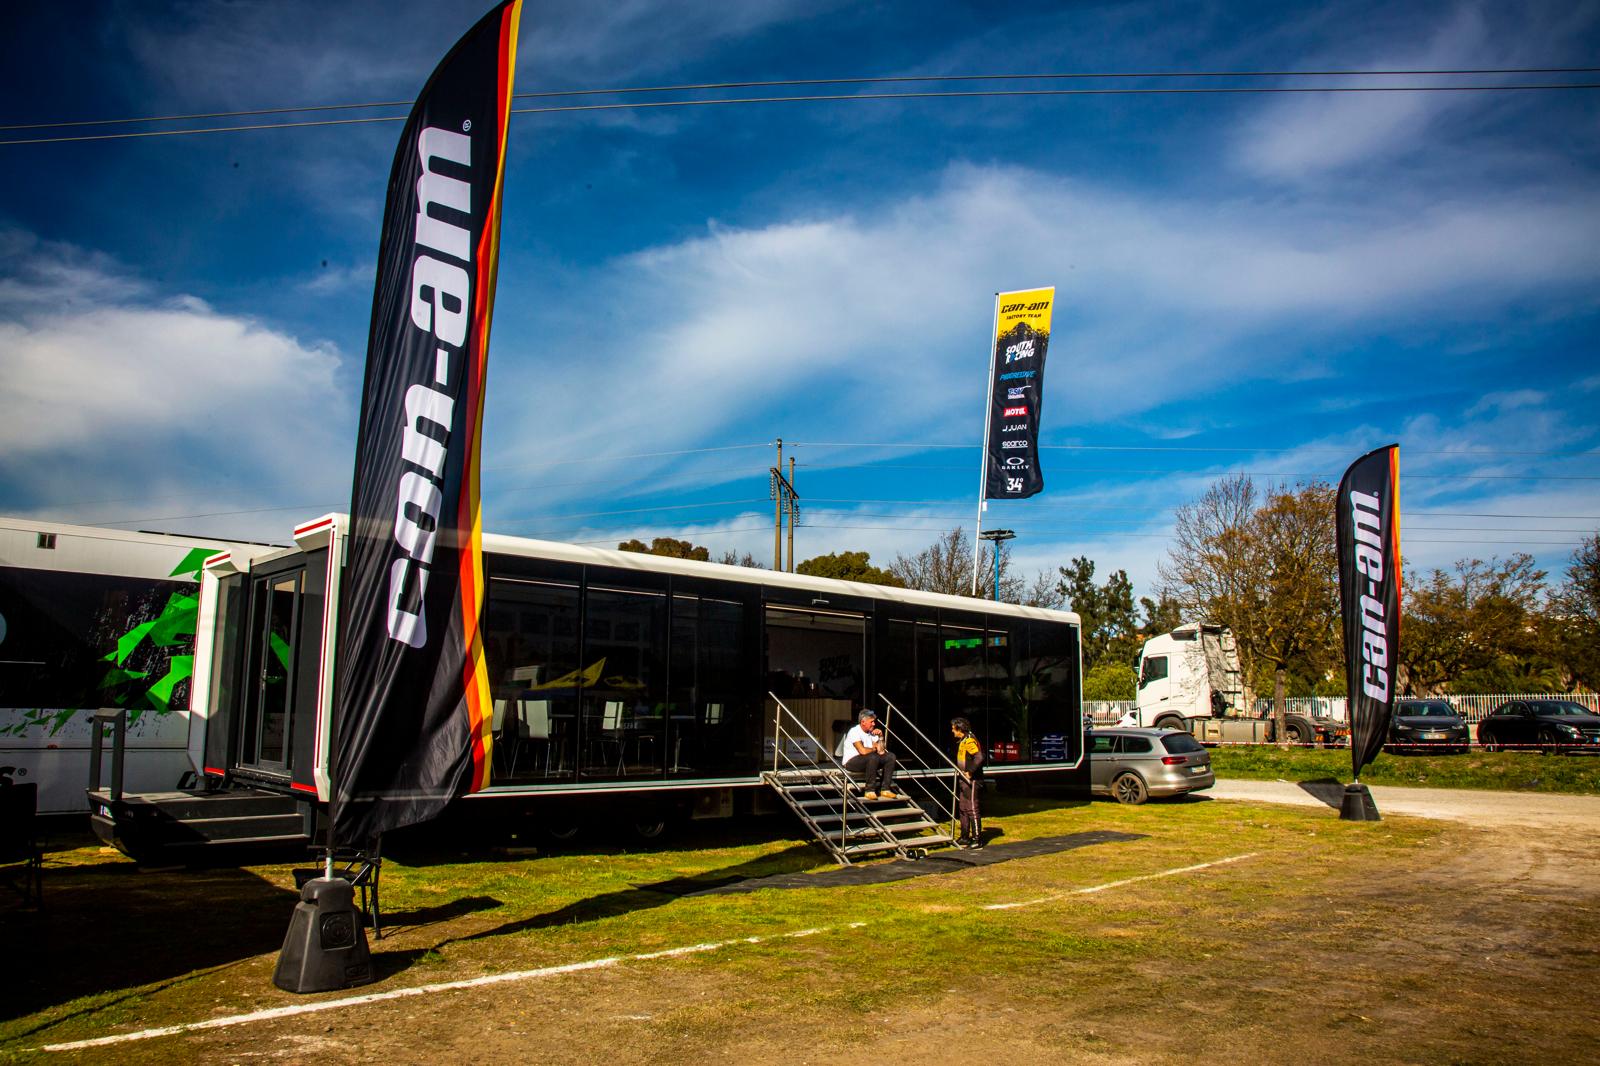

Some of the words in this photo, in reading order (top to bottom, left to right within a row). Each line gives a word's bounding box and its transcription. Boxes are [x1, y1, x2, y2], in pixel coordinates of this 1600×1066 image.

[1001, 301, 1049, 314] can-am
[1006, 339, 1034, 354] SOUTH
[1005, 407, 1026, 416] MOTUL
